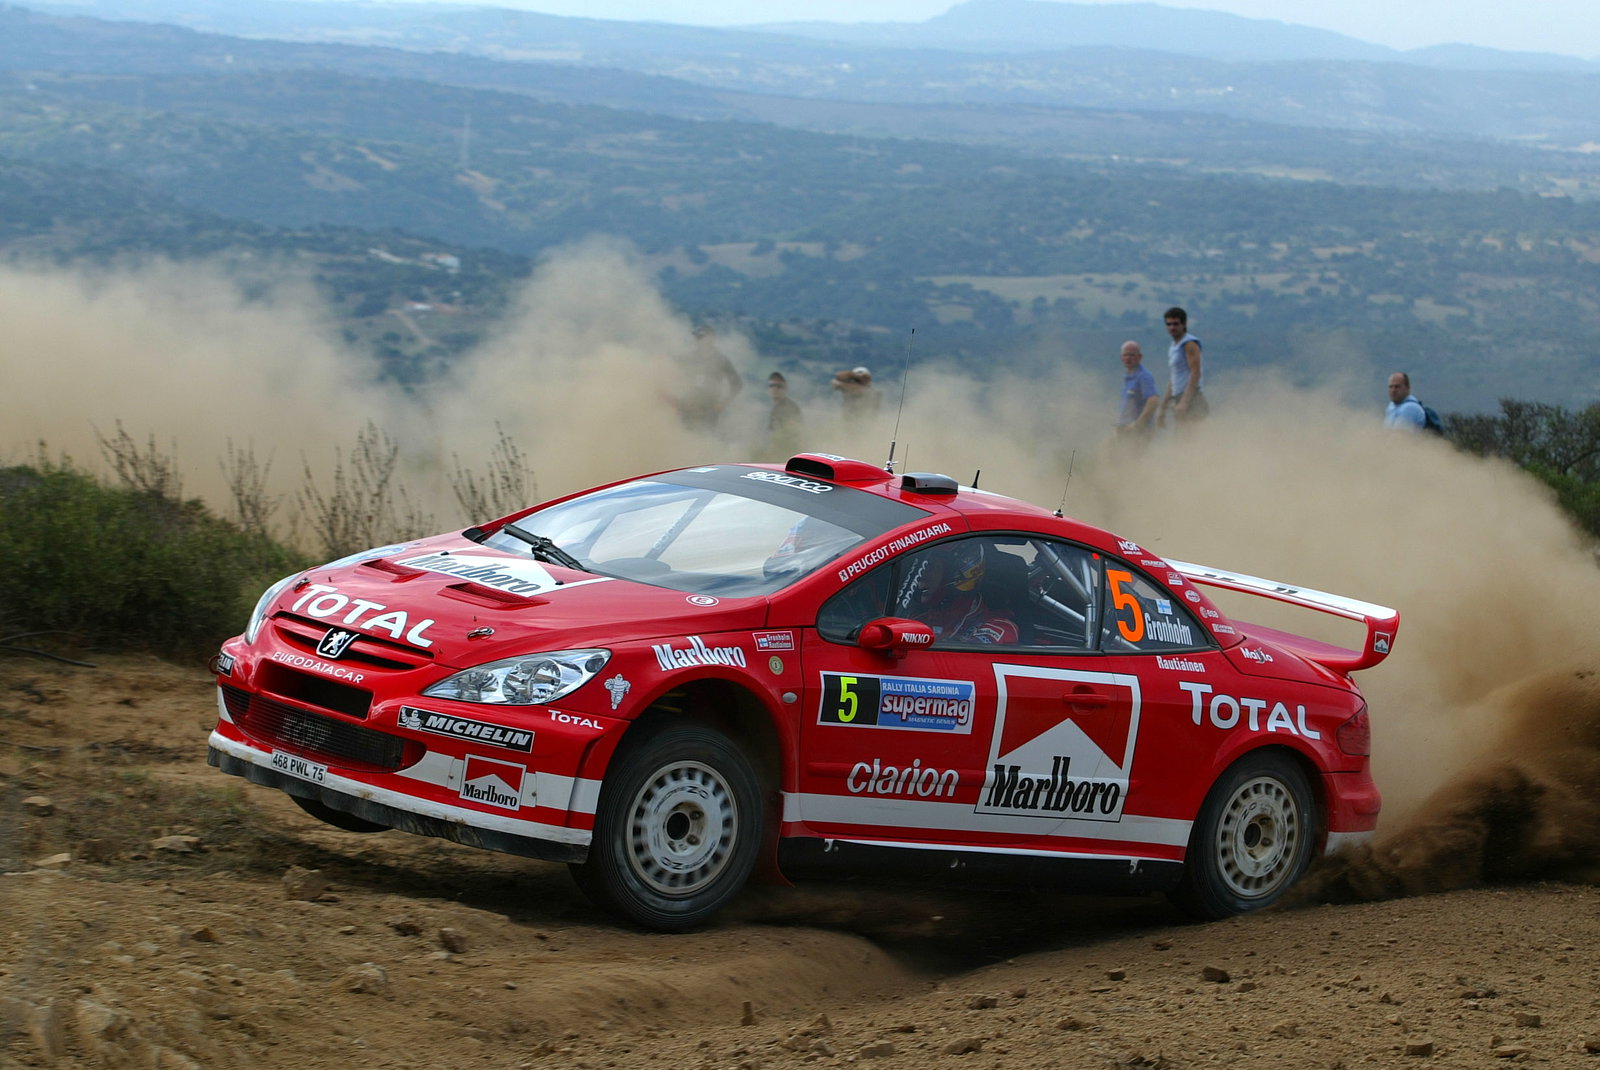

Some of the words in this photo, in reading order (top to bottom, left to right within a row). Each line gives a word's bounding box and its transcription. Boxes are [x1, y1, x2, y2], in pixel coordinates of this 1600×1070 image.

[743, 471, 833, 493] sparco
[847, 546, 889, 577] PEUGEOT
[888, 522, 952, 553] FINANZIARIA
[405, 555, 541, 593] Marlboro
[291, 584, 435, 648] TOTAL
[1107, 569, 1144, 642] 5
[901, 632, 930, 643] NIKKO
[1144, 612, 1193, 645] Gronholm
[272, 651, 364, 683] EURODATACAR
[651, 635, 747, 671] Marlboro
[1156, 655, 1206, 673] Rautiainen
[837, 676, 858, 722] 5
[882, 682, 903, 692] RALLY
[904, 683, 926, 693] ITALIA
[927, 685, 960, 695] SARDINIA
[548, 709, 604, 730] TOTAL
[882, 695, 969, 724] supermag
[1179, 681, 1320, 740] TOTAL
[425, 715, 531, 746] MICHELIN
[272, 753, 288, 769] 468
[290, 759, 310, 777] PWL
[312, 765, 325, 782] 75
[847, 758, 959, 797] Clarion
[462, 783, 518, 807] Marlboro
[985, 756, 1121, 815] Marlboro
